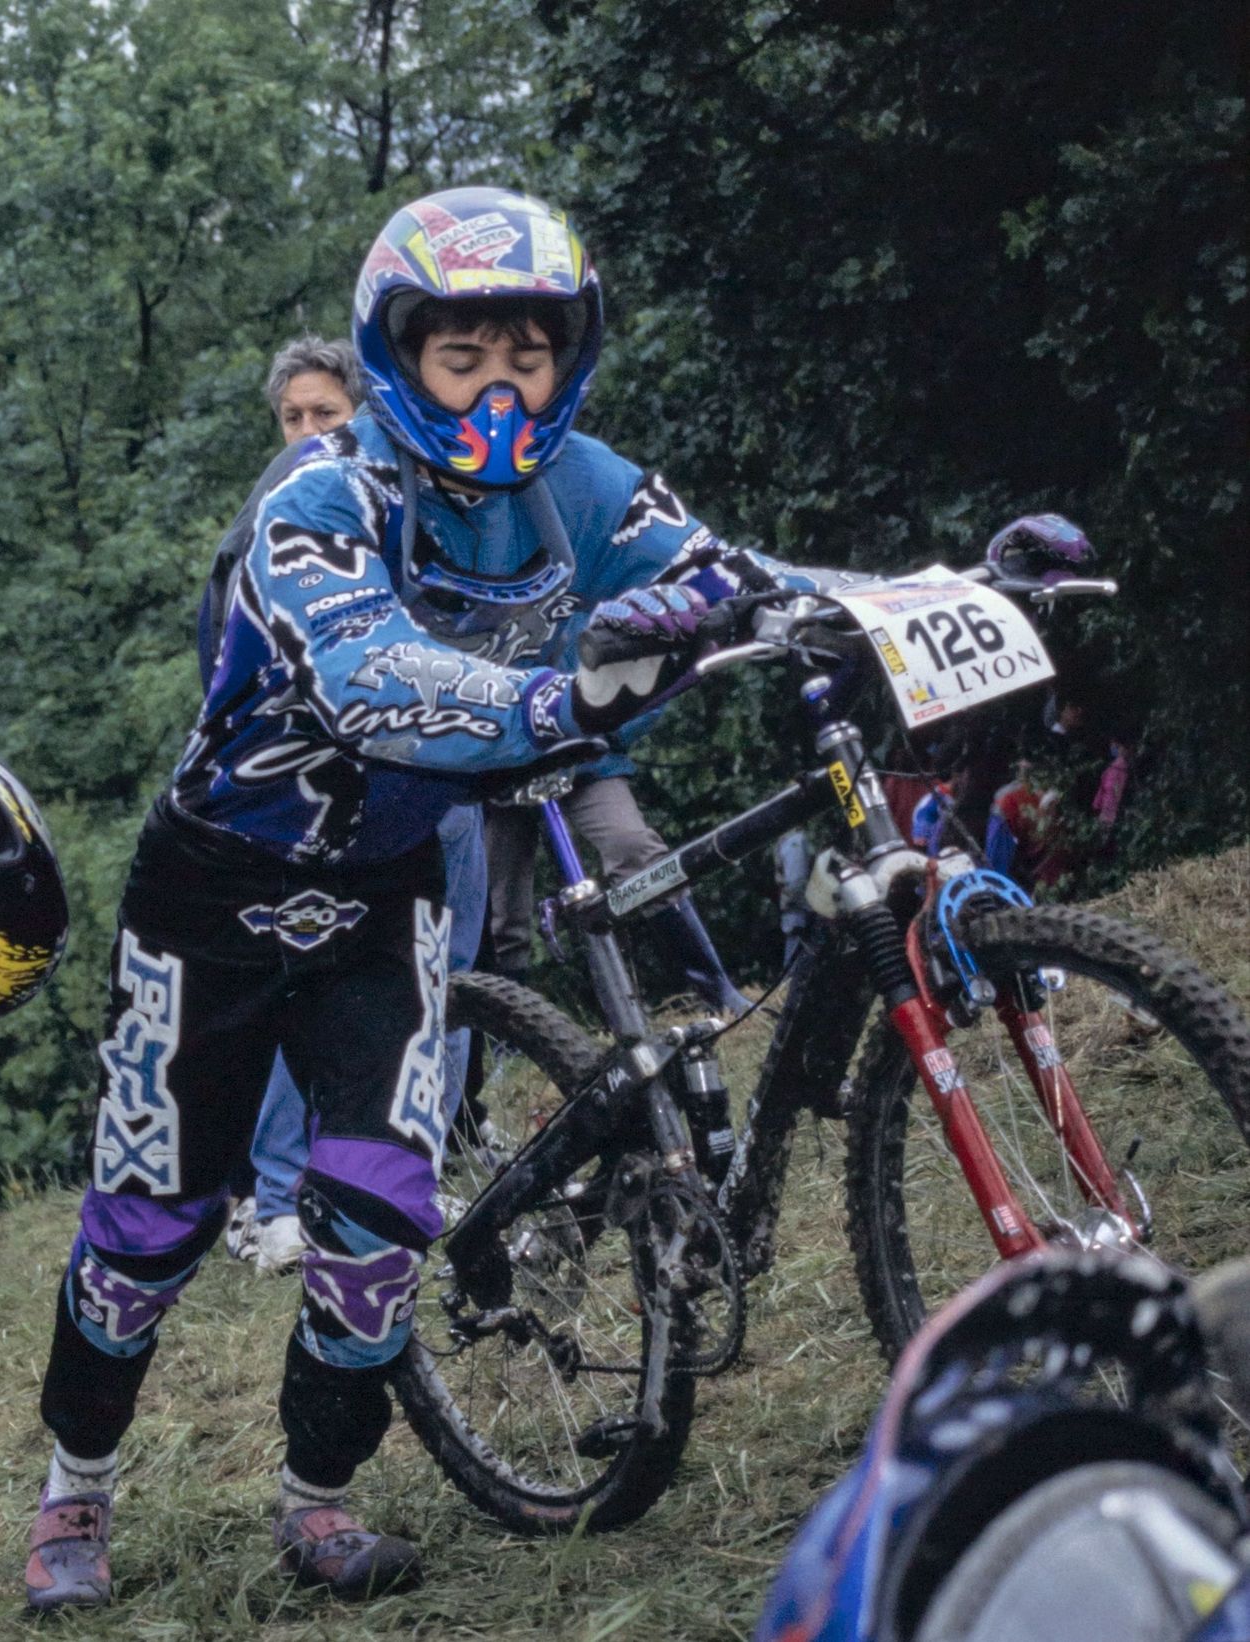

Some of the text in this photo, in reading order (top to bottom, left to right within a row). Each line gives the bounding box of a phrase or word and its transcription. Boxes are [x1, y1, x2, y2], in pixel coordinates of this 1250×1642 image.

[430, 214, 499, 251] FRANCE
[461, 229, 513, 253] MOTO
[905, 603, 1005, 672] 126
[955, 646, 1042, 693] LYON
[610, 858, 679, 908] FRANCE MOTO
[279, 904, 338, 926] 360
